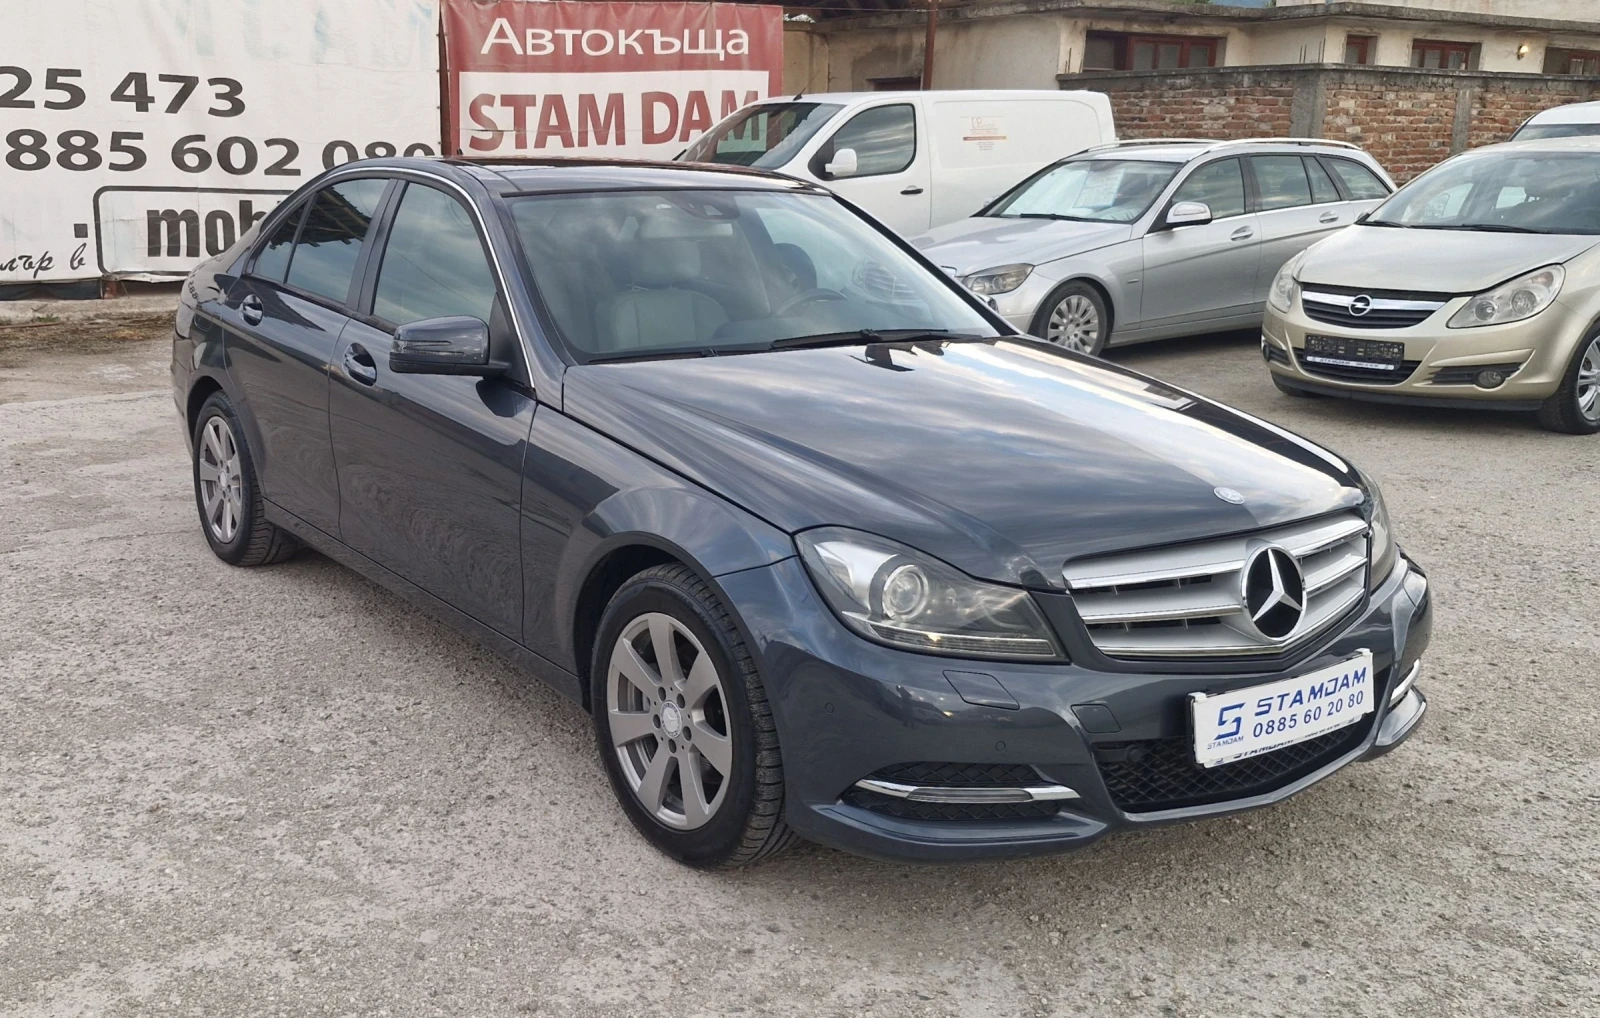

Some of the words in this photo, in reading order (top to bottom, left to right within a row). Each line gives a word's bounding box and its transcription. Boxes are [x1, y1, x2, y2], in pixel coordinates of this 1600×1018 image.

[480, 17, 749, 61] Автокъща
[0, 65, 86, 110] 25
[110, 71, 246, 118] 473
[469, 92, 626, 151] STAM
[641, 90, 759, 145] DAM
[5, 128, 147, 172] 885
[171, 134, 301, 176] 602
[1252, 713, 1298, 738] 0885
[1303, 706, 1322, 725] 60
[1327, 698, 1343, 717] 20
[1347, 690, 1364, 709] 80
